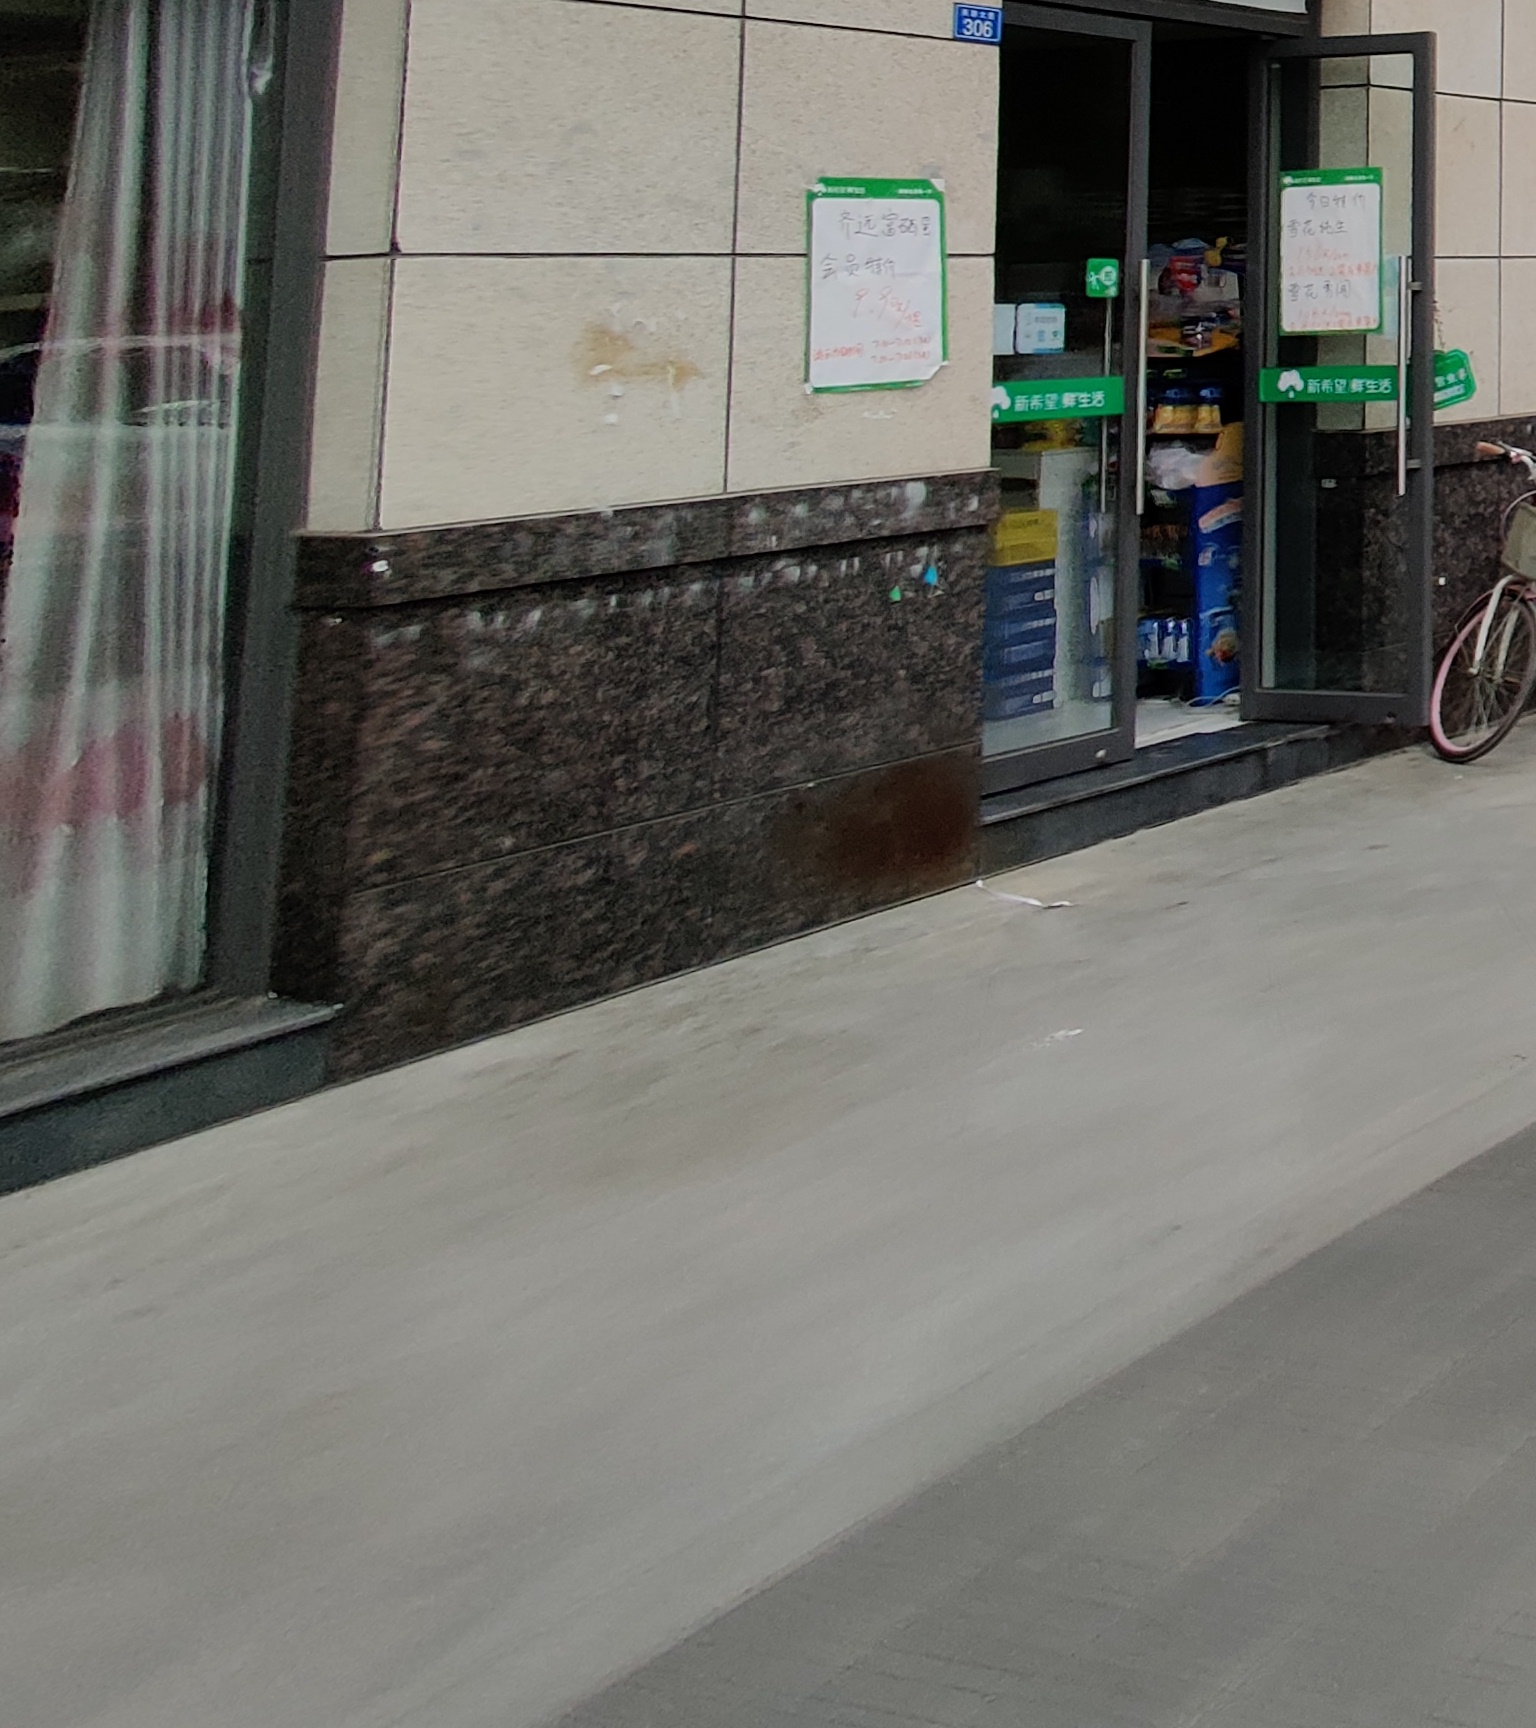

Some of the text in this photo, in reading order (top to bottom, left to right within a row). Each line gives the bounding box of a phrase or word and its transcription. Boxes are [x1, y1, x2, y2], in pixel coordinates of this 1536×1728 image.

[962, 18, 994, 38] 306
[1306, 378, 1348, 395] 新希望
[1014, 393, 1060, 412] 新希望
